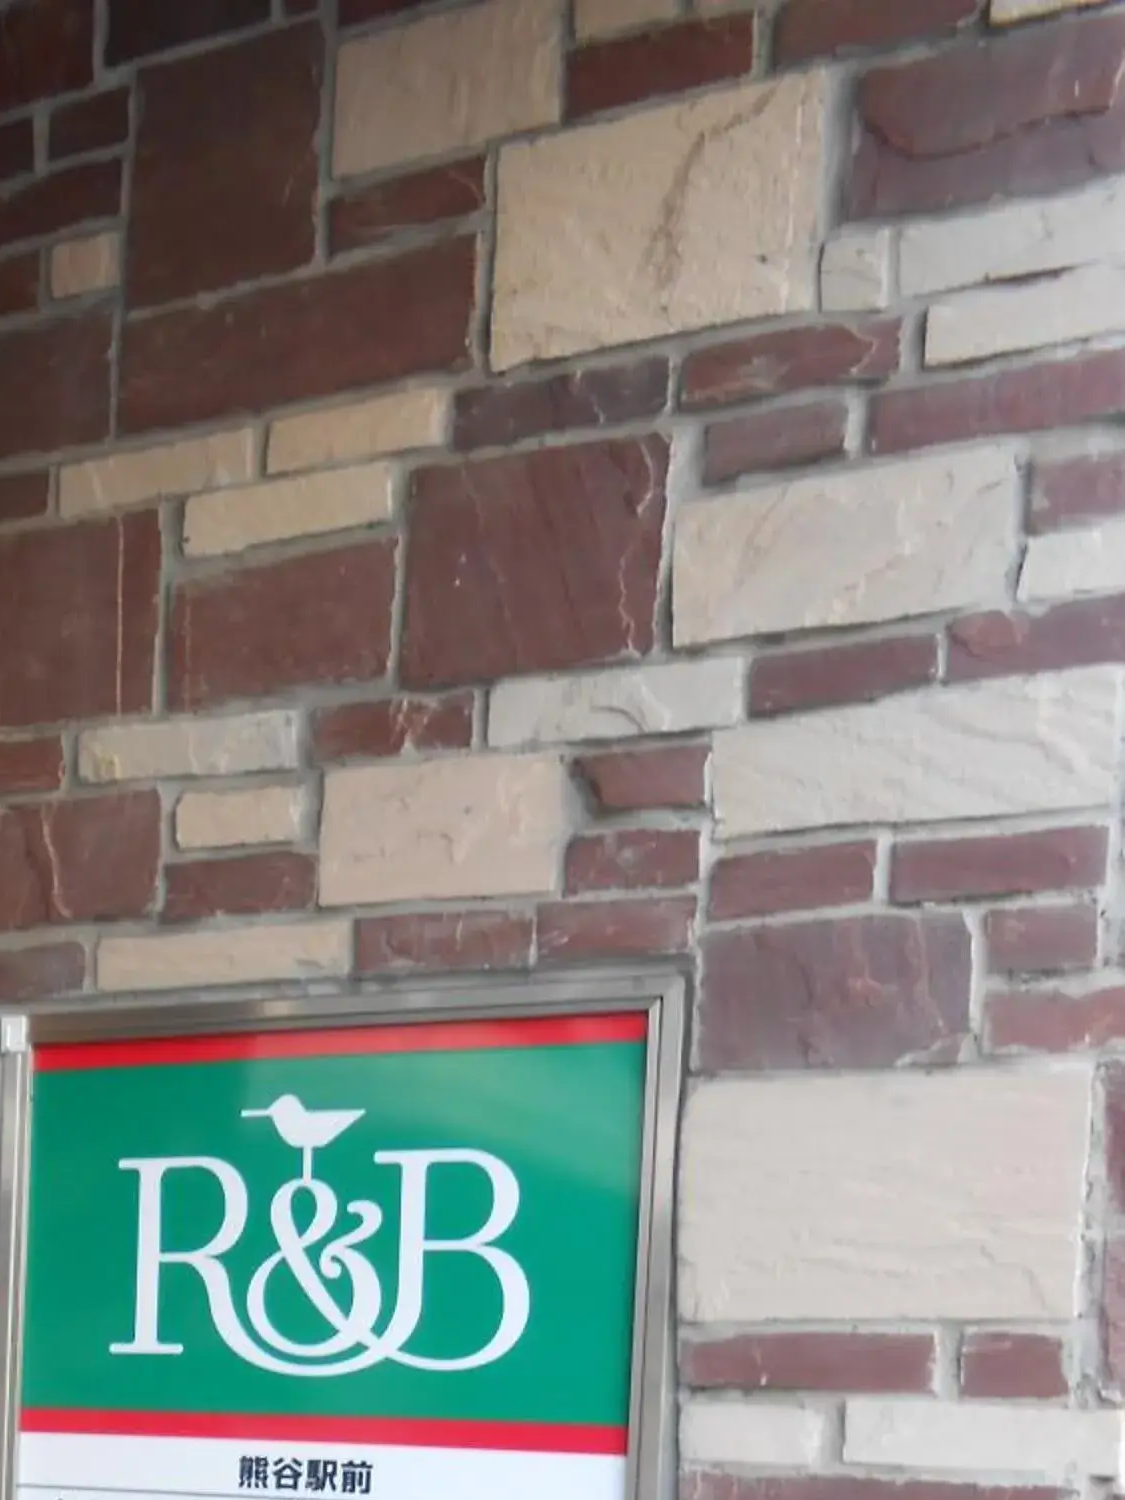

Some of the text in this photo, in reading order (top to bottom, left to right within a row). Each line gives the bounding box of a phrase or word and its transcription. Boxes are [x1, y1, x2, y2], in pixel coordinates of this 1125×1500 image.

[109, 1148, 531, 1377] R&B
[238, 1455, 374, 1495] 熊谷駅前
